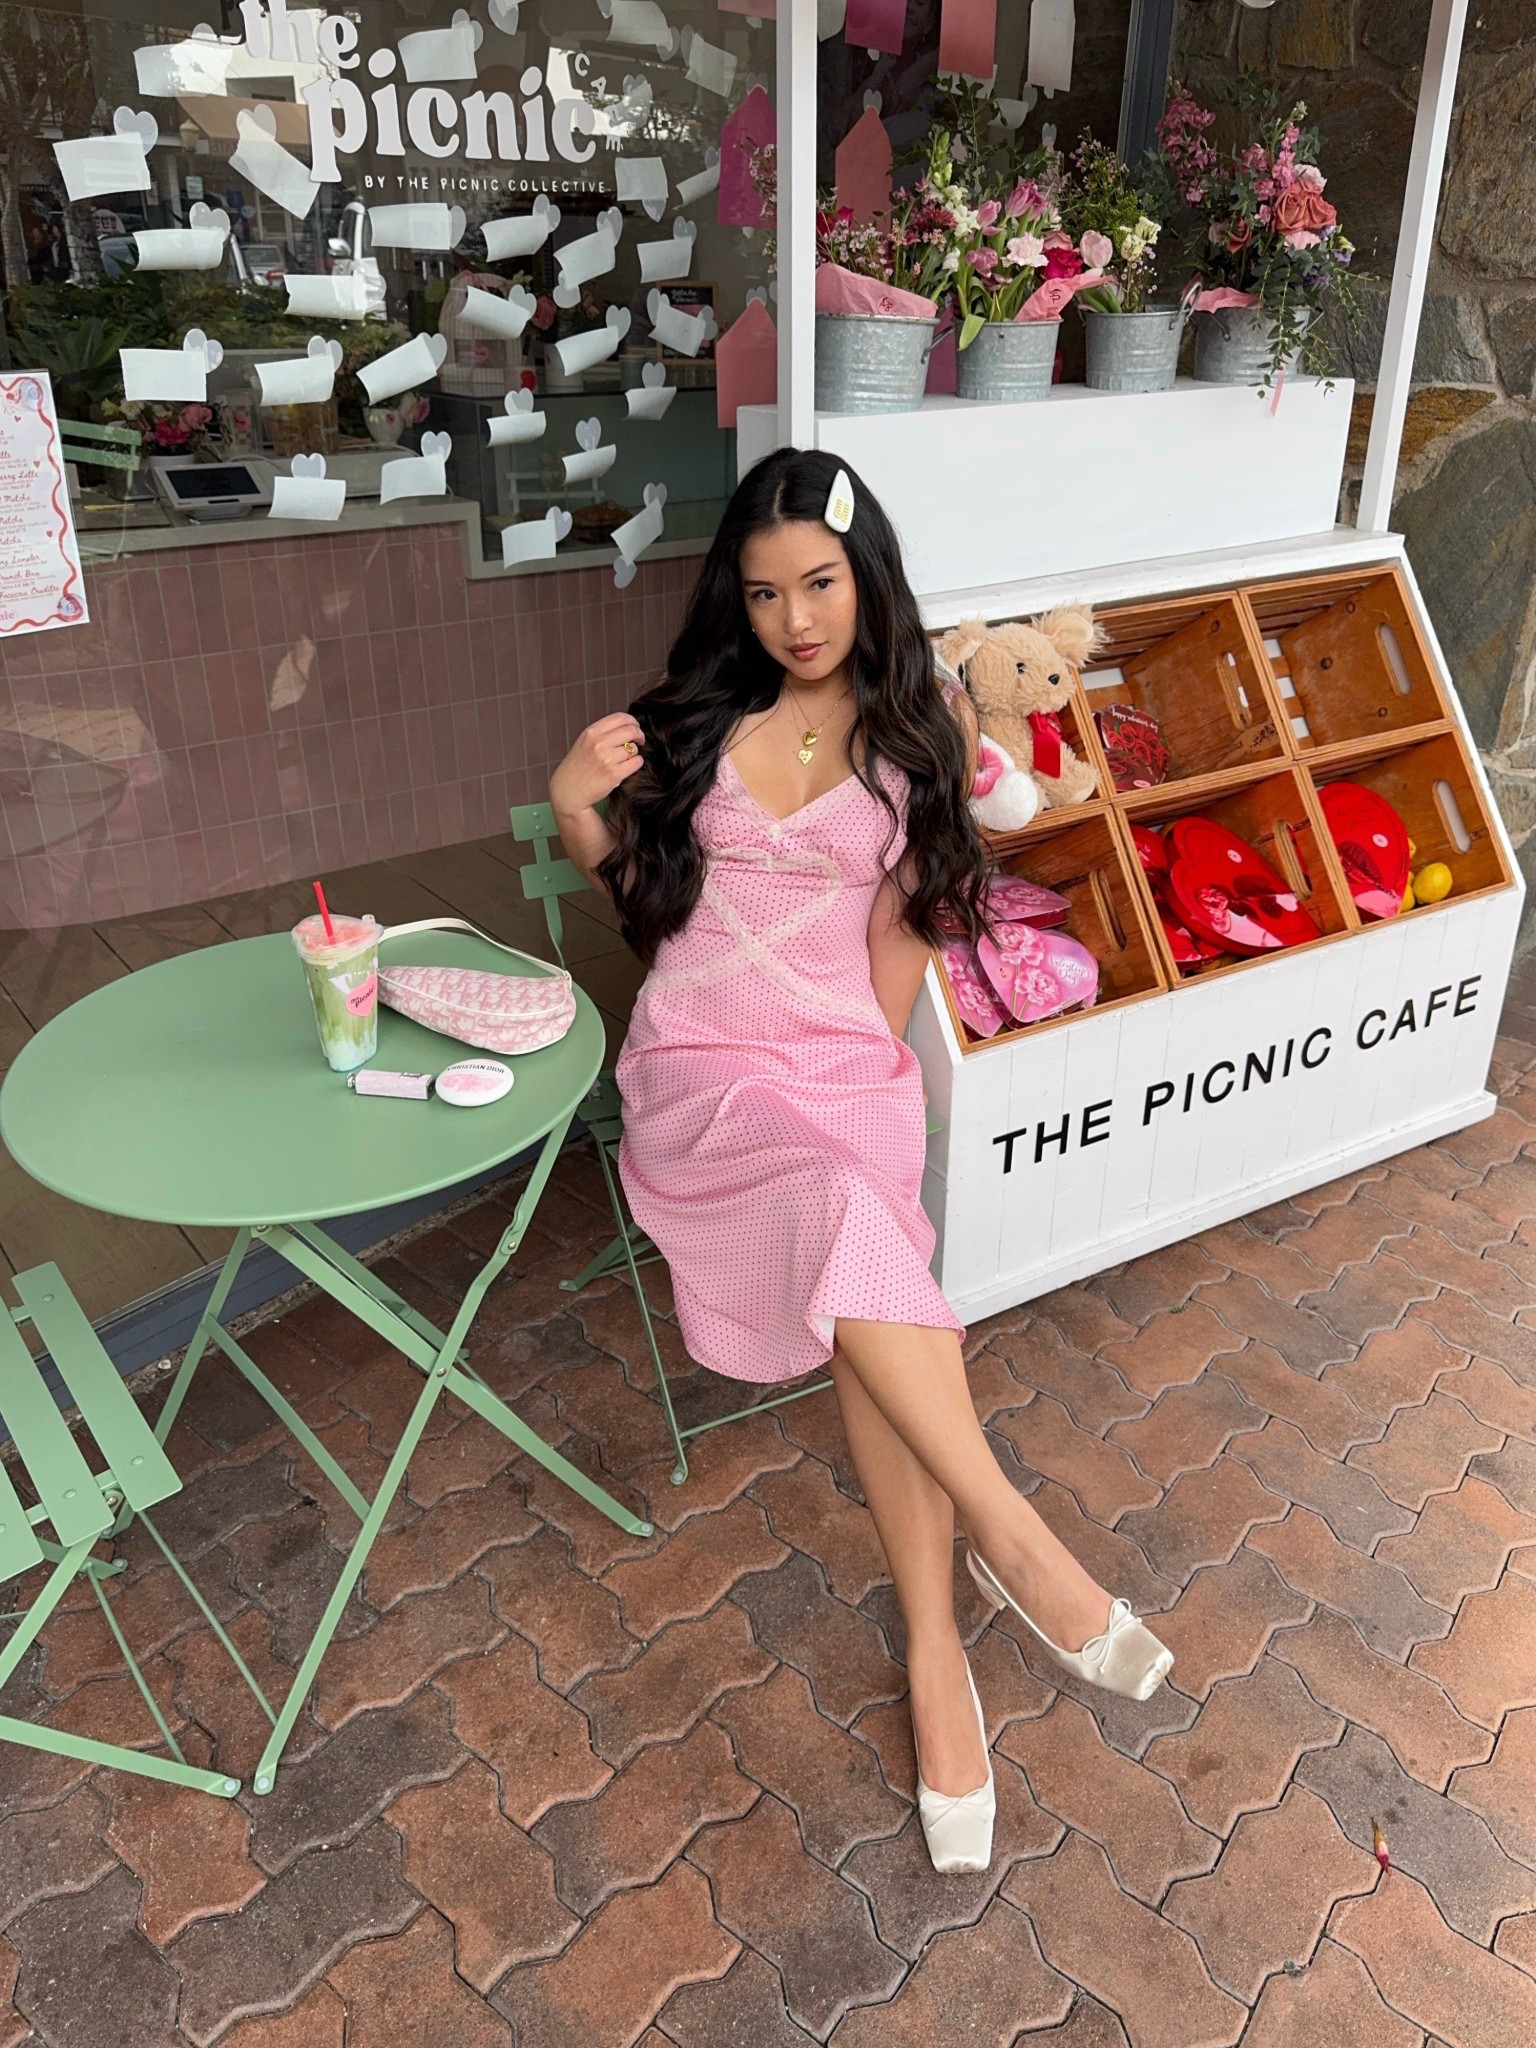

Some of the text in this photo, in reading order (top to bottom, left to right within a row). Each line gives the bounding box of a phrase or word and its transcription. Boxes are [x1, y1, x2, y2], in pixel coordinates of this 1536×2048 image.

[239, 0, 360, 69] the
[301, 48, 596, 182] picnic
[365, 176, 605, 193] BY THE PICNIC COLLECTIVE
[486, 1065, 505, 1074] DIOR
[993, 975, 1482, 1174] THE PICNIC CAFE
